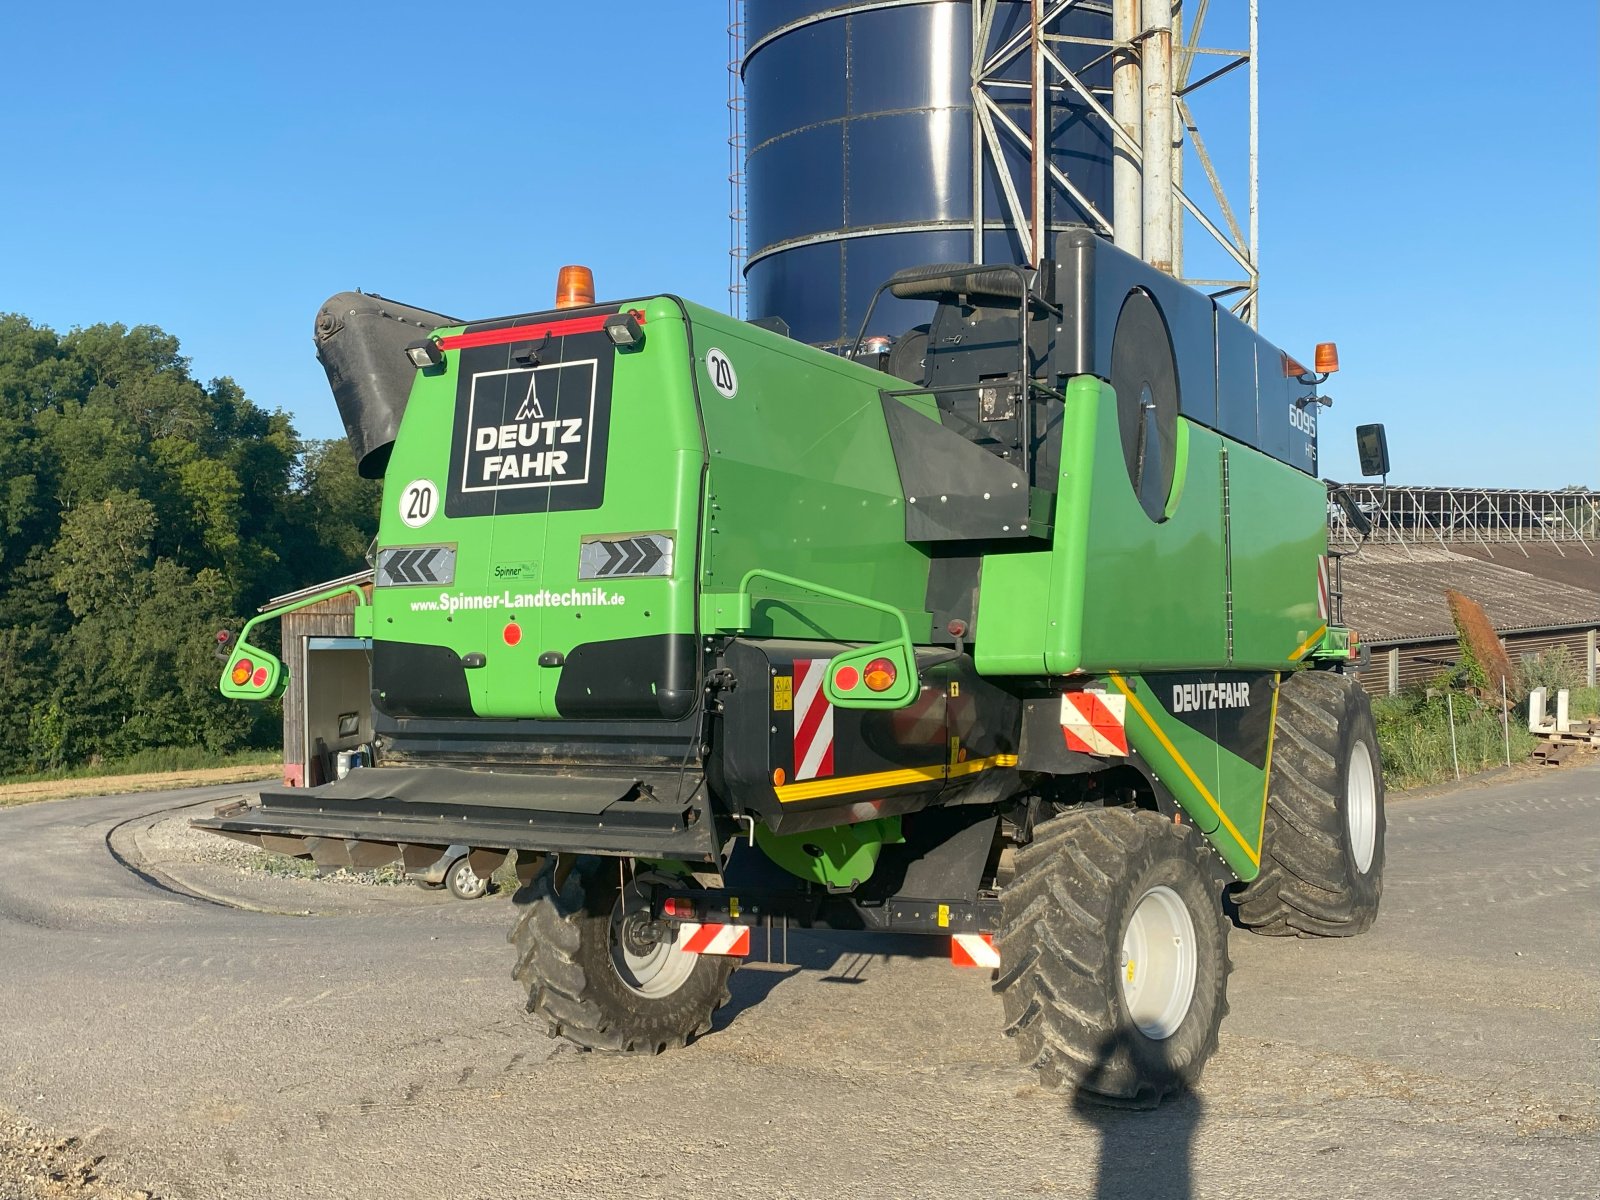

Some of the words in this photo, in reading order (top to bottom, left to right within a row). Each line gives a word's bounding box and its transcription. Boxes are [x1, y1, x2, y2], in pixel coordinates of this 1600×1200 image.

[711, 355, 733, 391] 20
[475, 418, 582, 452] DEUTZ
[1289, 403, 1316, 438] 6095
[482, 451, 568, 481] FAHR
[407, 487, 431, 520] 20
[494, 565, 522, 579] Spinner
[410, 587, 625, 614] www.Spinner-Landtechnik.de
[1172, 682, 1251, 713] DEUTZ-FAHR
